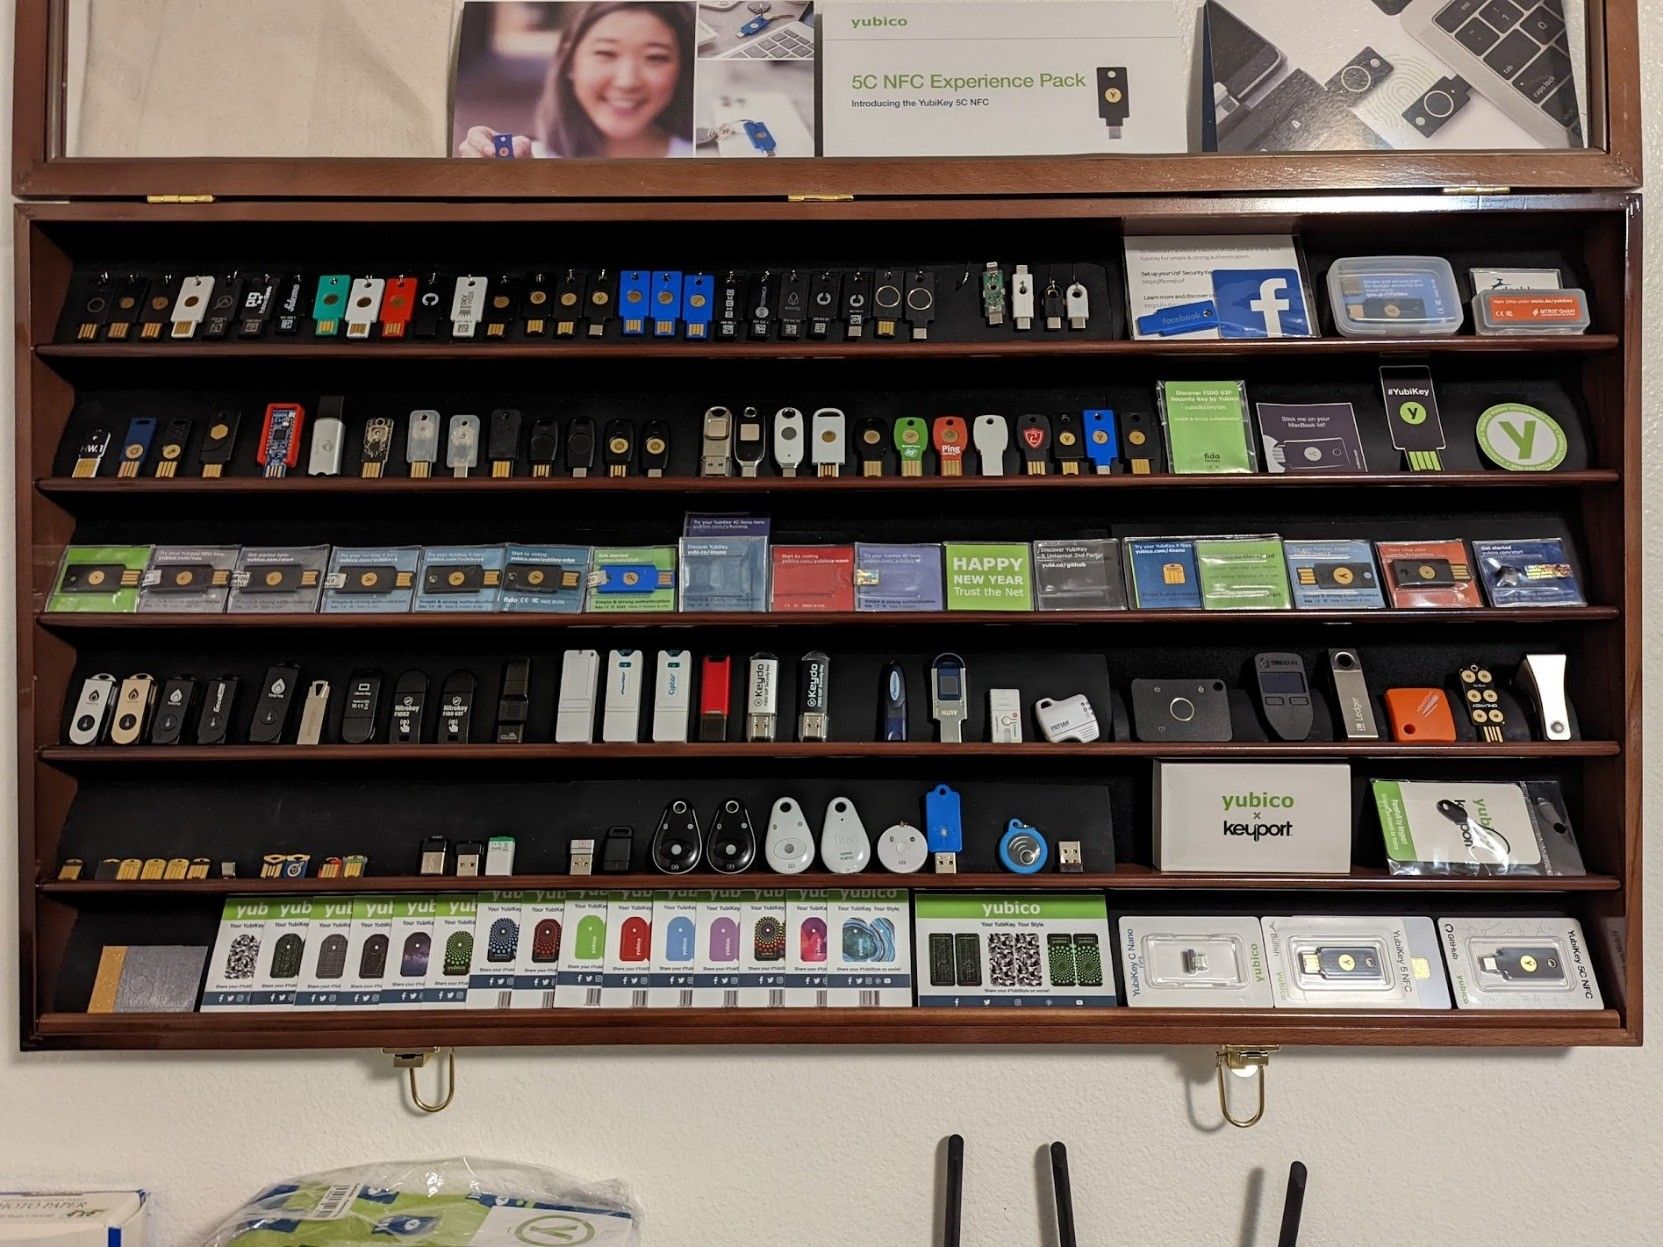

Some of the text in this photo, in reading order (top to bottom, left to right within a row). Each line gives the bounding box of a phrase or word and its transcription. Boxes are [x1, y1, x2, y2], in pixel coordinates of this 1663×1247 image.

[851, 16, 908, 29] yubico
[851, 72, 1086, 93] 5C NFC Experience Pack
[851, 98, 990, 109] Introducing the YubiKey 5C NFC
[1388, 387, 1430, 397] #YubiKey
[942, 445, 960, 454] Ping
[953, 557, 1023, 571] HAPPY
[1042, 561, 1087, 569] yubi.co/github
[953, 575, 1023, 585] NEW YEAR
[953, 587, 1024, 597] Trust the Net
[755, 663, 765, 697] Keydo
[808, 663, 819, 697] Keydo
[443, 705, 468, 713] Nitrokey
[1351, 696, 1364, 722] Ledger
[1222, 792, 1294, 811] yubico
[1223, 820, 1291, 841] keyport
[493, 890, 523, 901] yub
[537, 890, 566, 901] yub
[580, 890, 608, 899] yub
[622, 890, 652, 899] yub
[668, 890, 697, 899] yub
[711, 889, 741, 899] yub
[755, 889, 784, 899] yub
[840, 888, 897, 899] yubico
[236, 902, 268, 918] yub
[280, 902, 312, 918] yub
[982, 901, 1041, 917] yubico
[1127, 929, 1136, 950] Nano
[1447, 934, 1459, 960] GitHub
[1251, 943, 1265, 982] yubico
[1392, 930, 1405, 963] YubiKey
[1402, 974, 1413, 993] NFC
[1568, 930, 1594, 1000] YubiKey 5C NFC
[1128, 962, 1140, 997] YubiKey
[1455, 975, 1468, 1005] yubico
